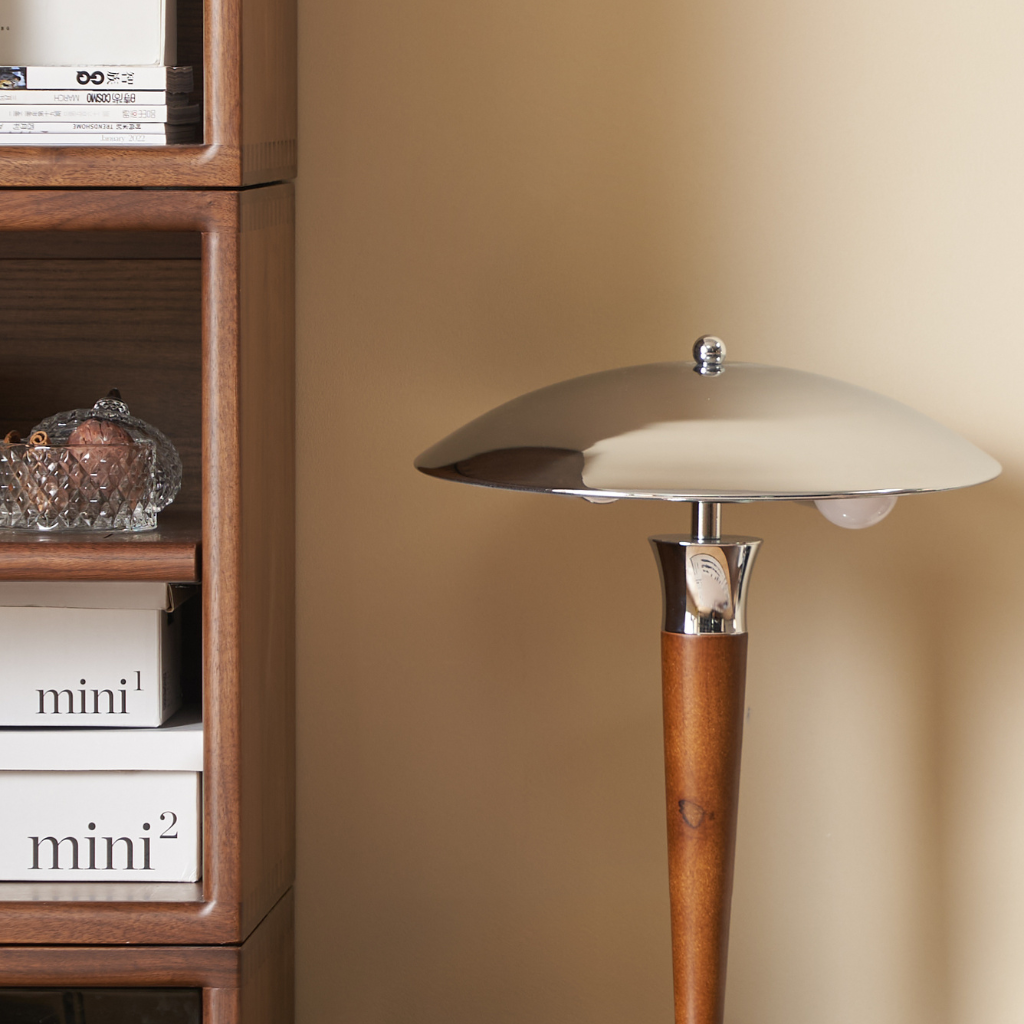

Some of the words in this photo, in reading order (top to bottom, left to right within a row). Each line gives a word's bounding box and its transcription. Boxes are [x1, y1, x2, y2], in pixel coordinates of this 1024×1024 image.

[77, 70, 104, 86] GQ
[54, 94, 80, 102] MARCH
[86, 93, 110, 104] COSMO
[72, 123, 114, 131] TRENDSHOME
[100, 134, 125, 143] January
